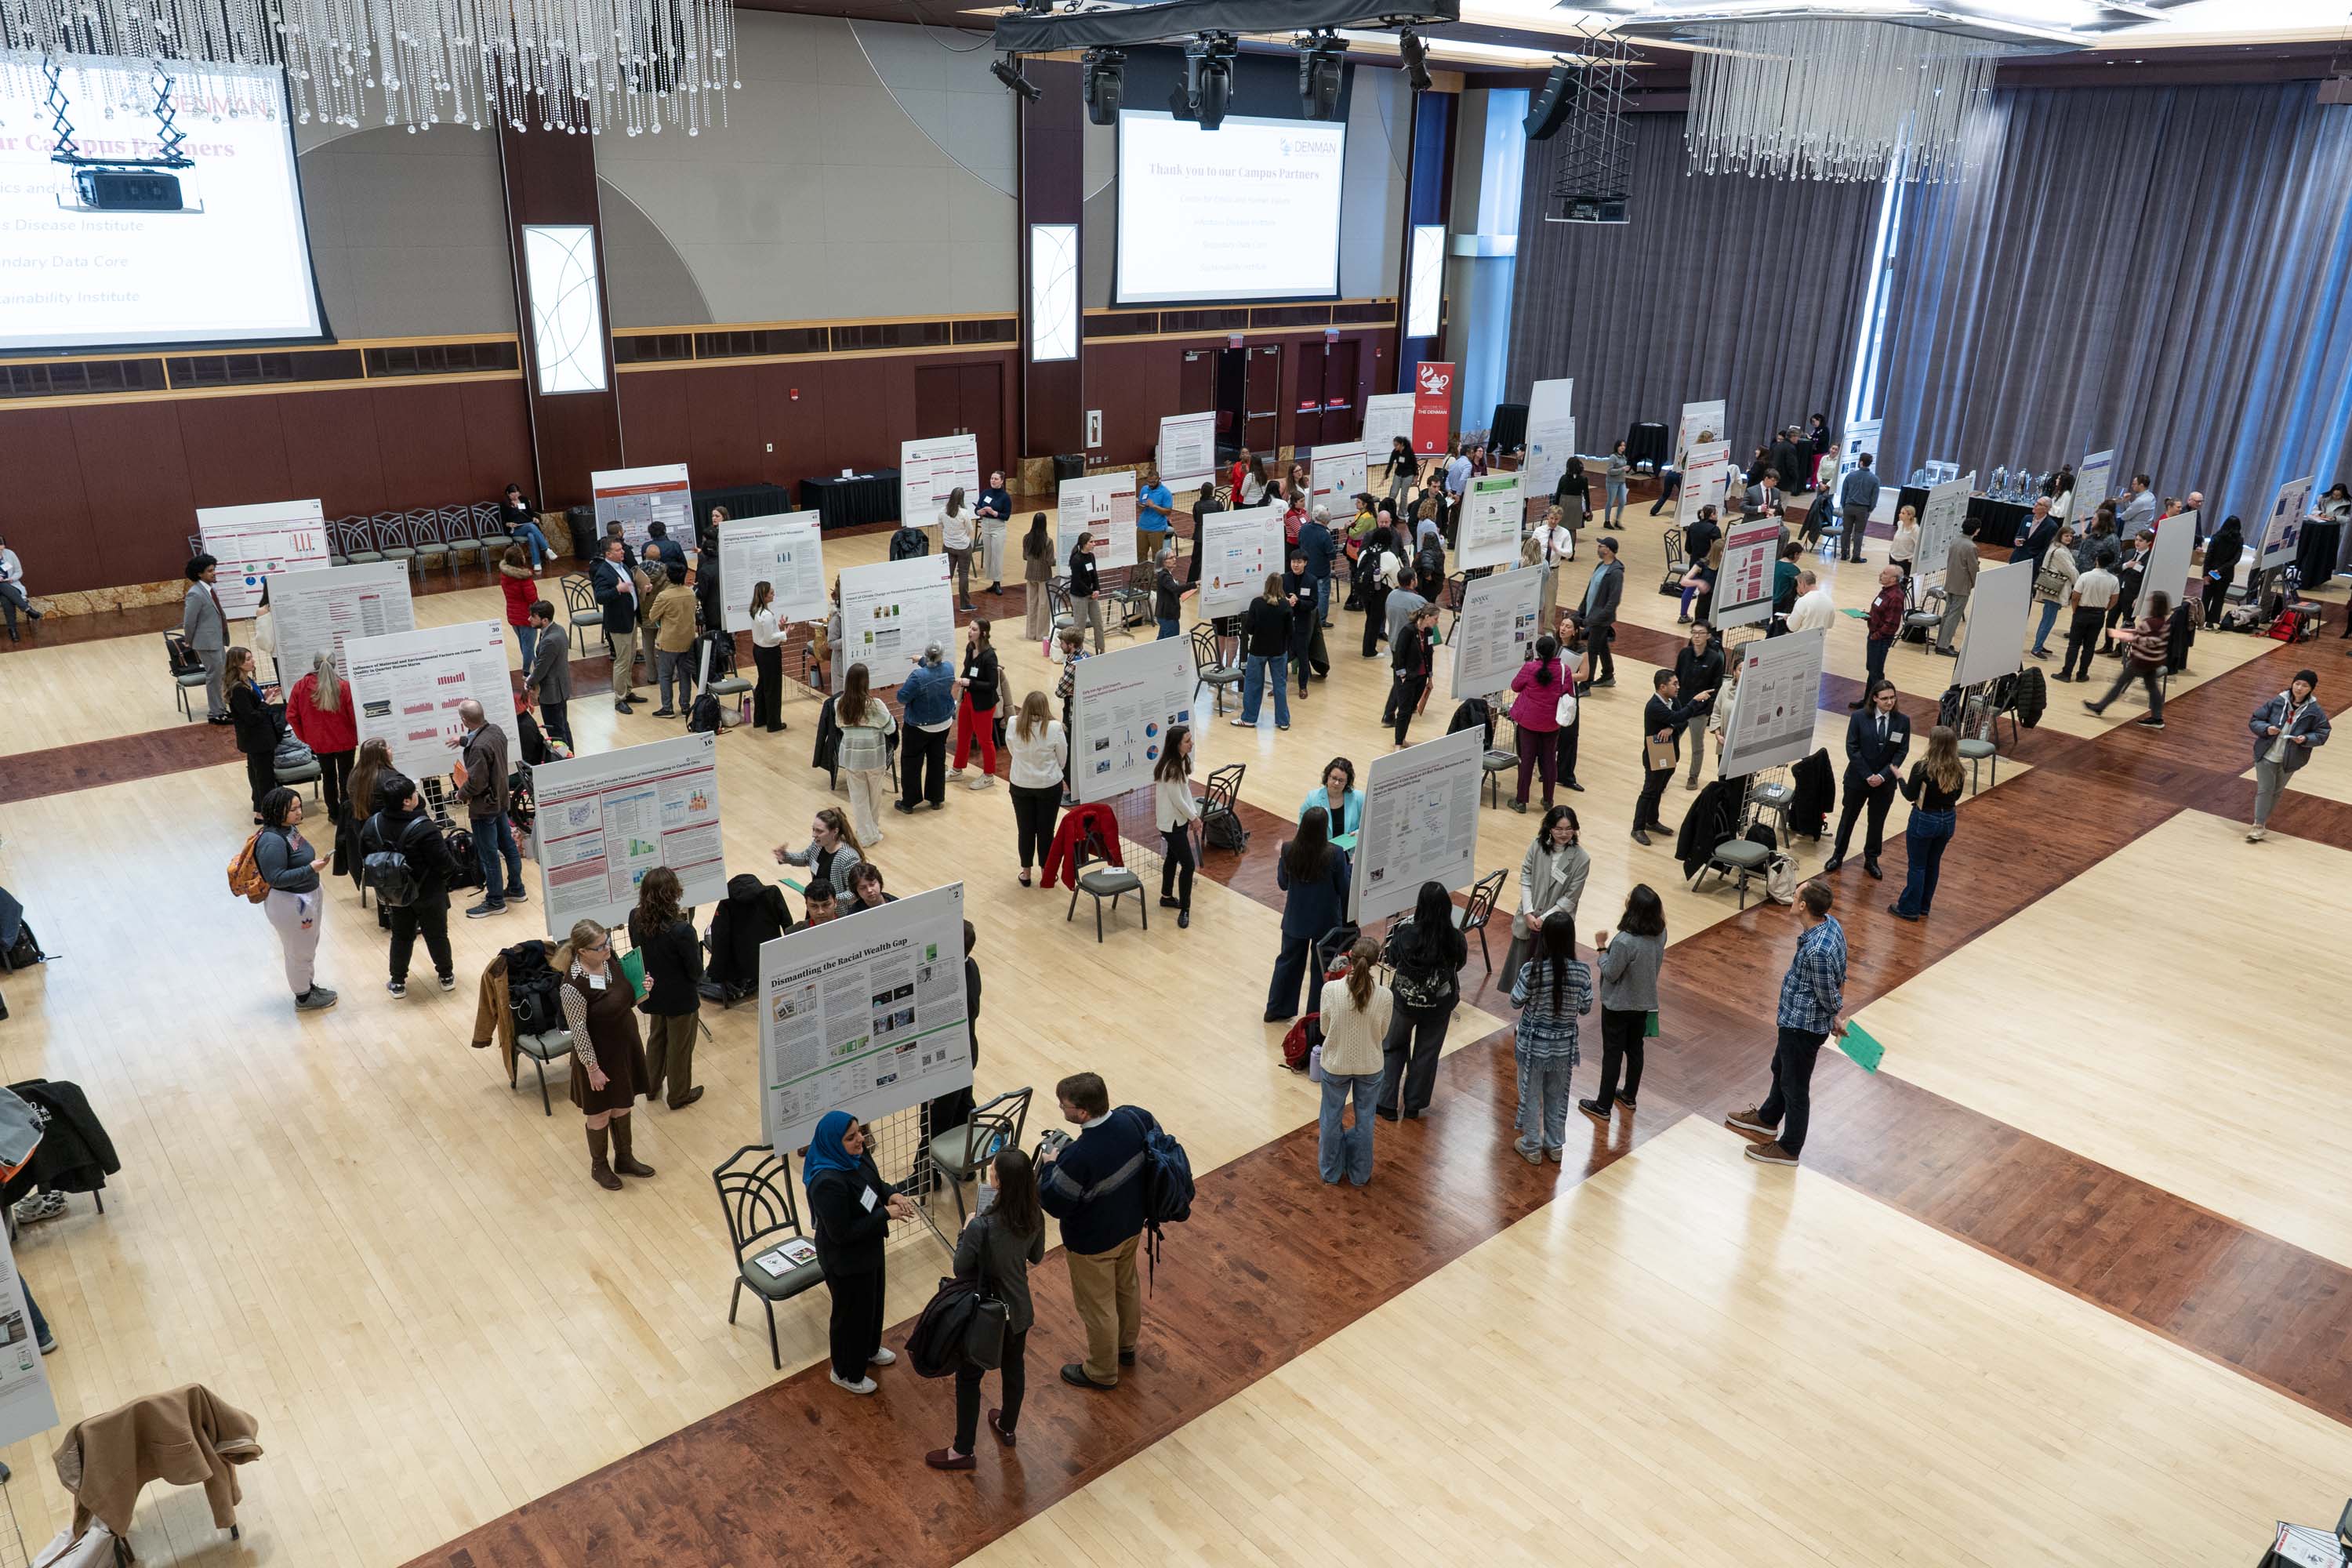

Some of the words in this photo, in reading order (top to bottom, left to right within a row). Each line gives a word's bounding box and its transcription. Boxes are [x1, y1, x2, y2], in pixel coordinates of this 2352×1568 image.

[132, 138, 235, 158] Paners
[1294, 140, 1336, 154] DENMAN
[1149, 162, 1182, 176] Thank
[1185, 165, 1204, 180] you
[1207, 166, 1216, 177] to
[1219, 168, 1236, 177] our
[1239, 166, 1276, 180] Campus
[1279, 168, 1319, 180] Partners
[26, 182, 56, 194] and
[16, 220, 75, 230] Disease
[82, 220, 145, 231] Institute
[53, 256, 89, 267] Data
[94, 256, 129, 267] Core
[78, 290, 140, 303] Institute
[353, 662, 373, 671] Influence
[408, 654, 438, 663] Environmental
[703, 739, 713, 747] 16
[539, 790, 557, 799] Blurring
[557, 786, 582, 794] Boundaries:
[641, 767, 672, 776] Homeschooling
[771, 967, 822, 988] Dismantling
[822, 961, 837, 971] the
[837, 952, 862, 965] Racial
[863, 943, 891, 956] Wealth
[892, 938, 908, 949] Gap
